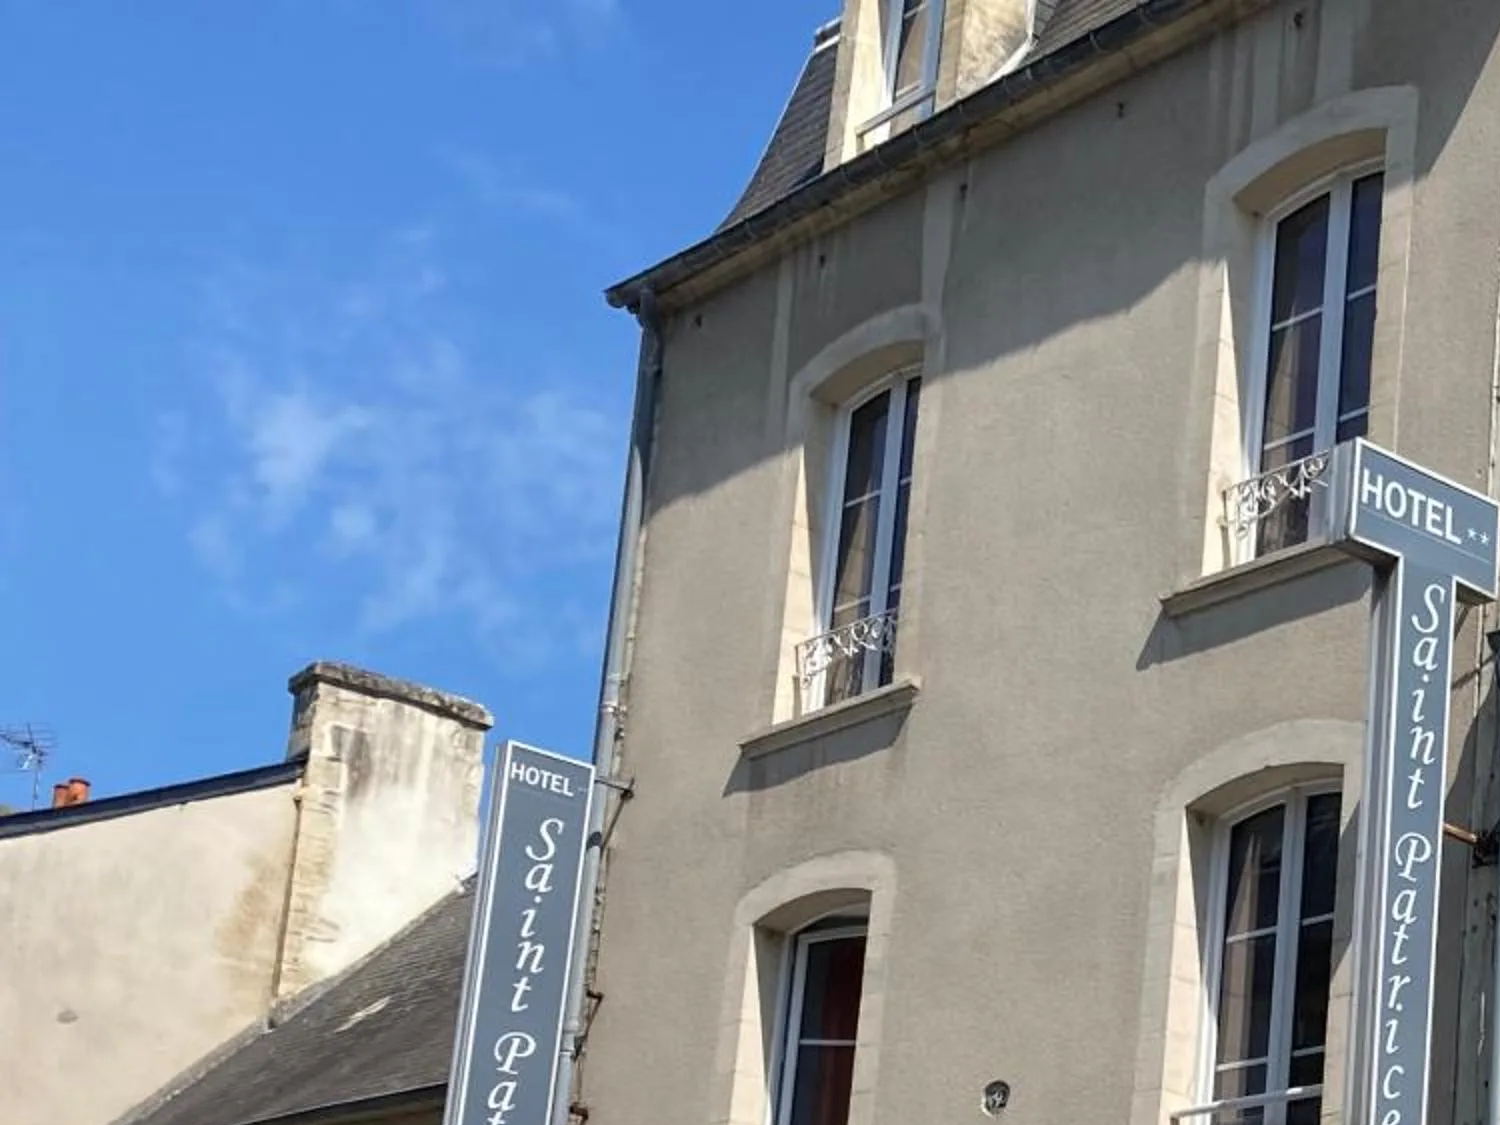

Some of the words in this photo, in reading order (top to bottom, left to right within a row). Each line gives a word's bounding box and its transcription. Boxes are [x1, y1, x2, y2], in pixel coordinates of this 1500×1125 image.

[1361, 468, 1461, 545] HOTEL
[1408, 583, 1445, 809] Saint
[511, 761, 574, 797] HOTEL
[510, 817, 564, 1013] Saint
